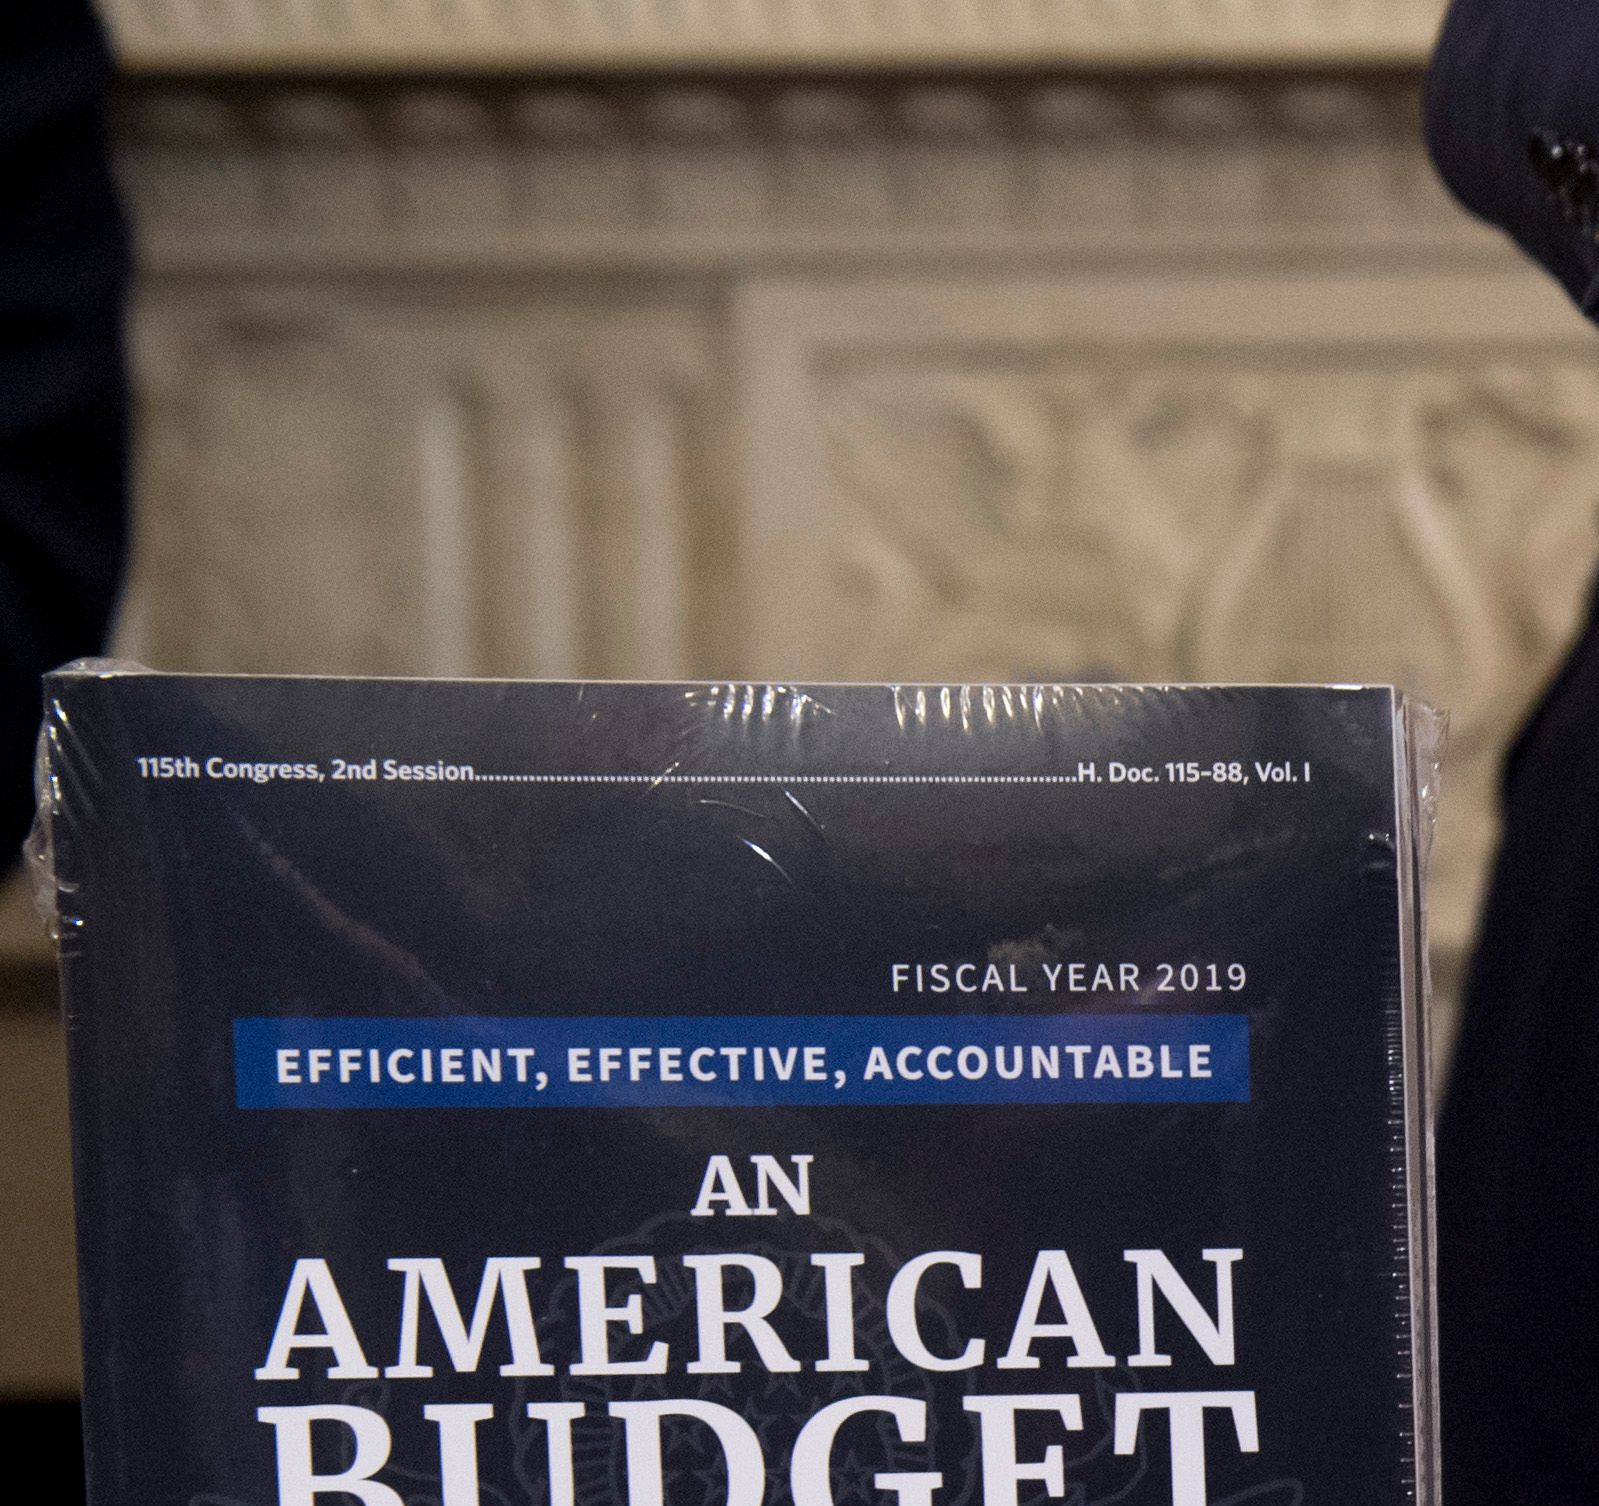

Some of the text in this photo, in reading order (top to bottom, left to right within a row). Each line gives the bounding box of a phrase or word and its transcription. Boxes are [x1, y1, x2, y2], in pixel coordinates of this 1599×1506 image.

[138, 757, 199, 778] 115th
[206, 757, 325, 783] Congress,
[332, 759, 376, 780] 2nd
[1109, 762, 1159, 782] Doc.
[1255, 762, 1297, 782] Vol.
[1304, 762, 1310, 782] I
[893, 964, 1245, 992] FISCAL YEAR 2019
[277, 1045, 1211, 1090] EFFICIENT, EFFECTIVE, ACCOUNTABLE
[691, 1155, 813, 1216] AN
[255, 1249, 1243, 1380] AMERICAN
